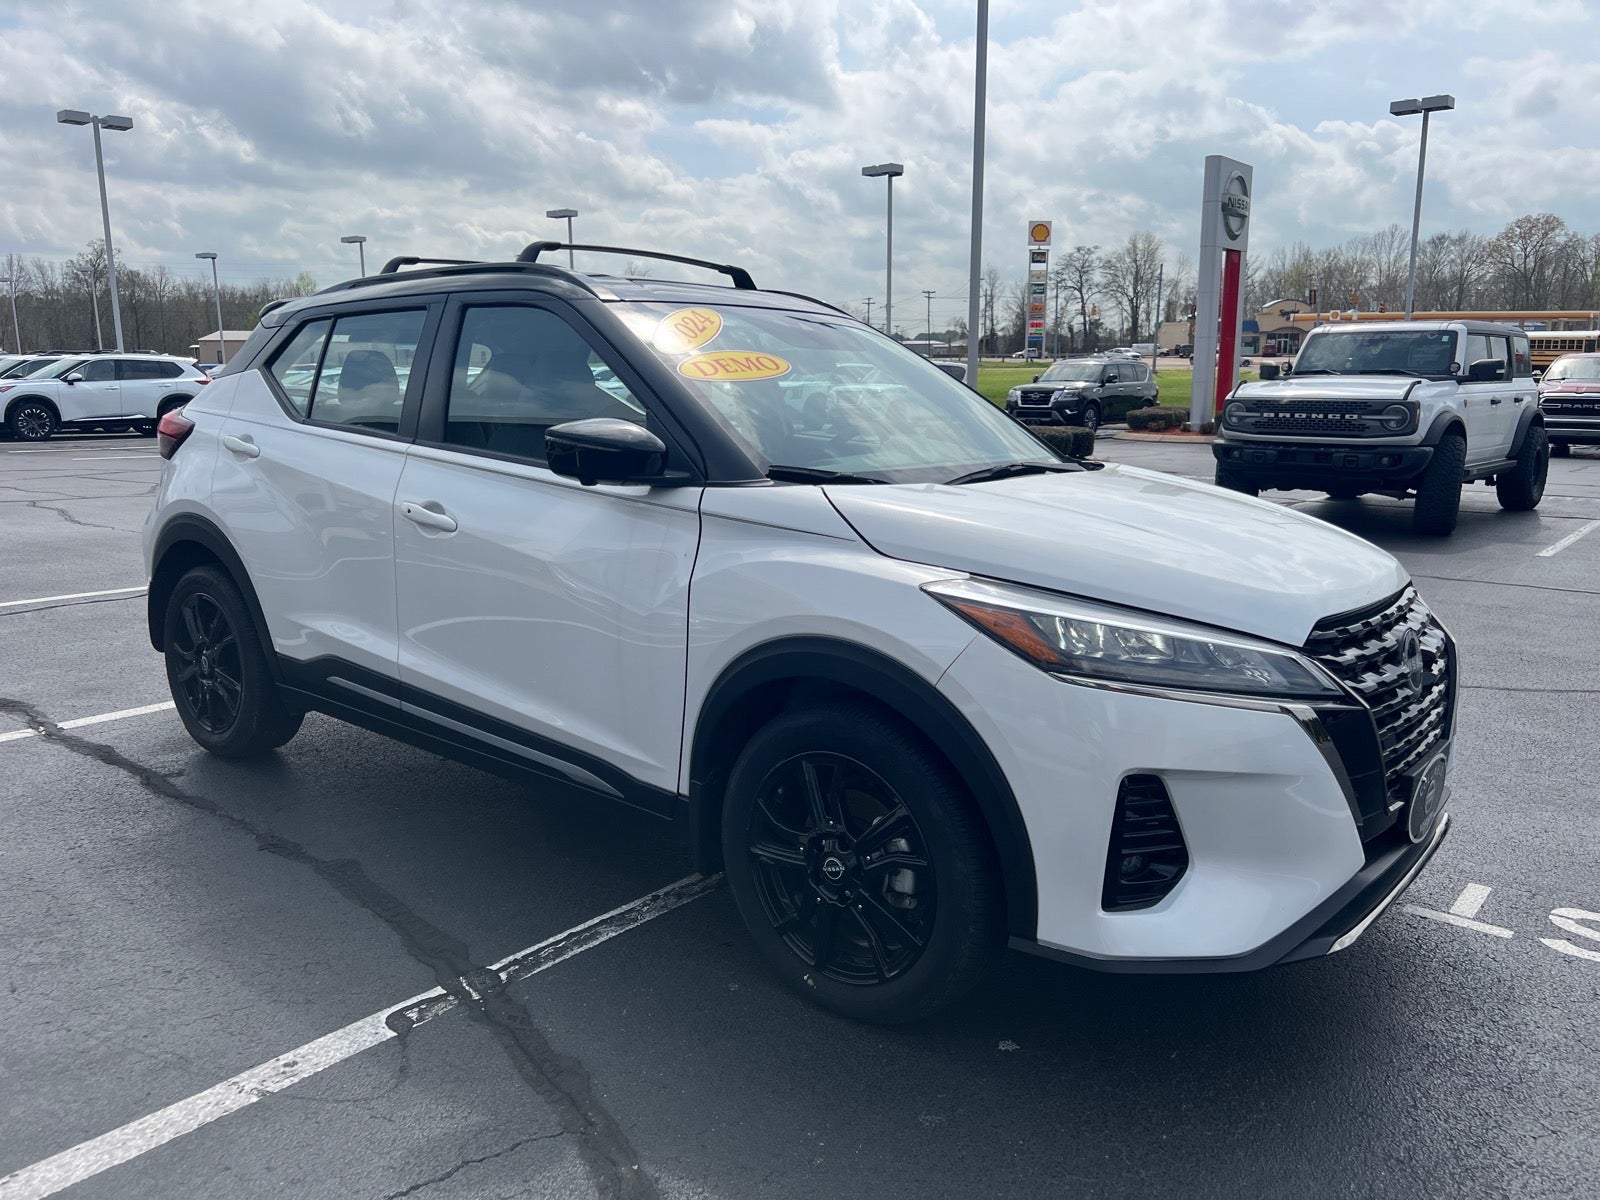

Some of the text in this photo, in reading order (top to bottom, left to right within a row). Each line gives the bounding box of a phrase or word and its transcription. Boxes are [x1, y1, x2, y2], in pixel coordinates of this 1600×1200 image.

[673, 310, 715, 343] 024
[693, 356, 780, 377] DEMO
[1263, 412, 1358, 420] BRONCO
